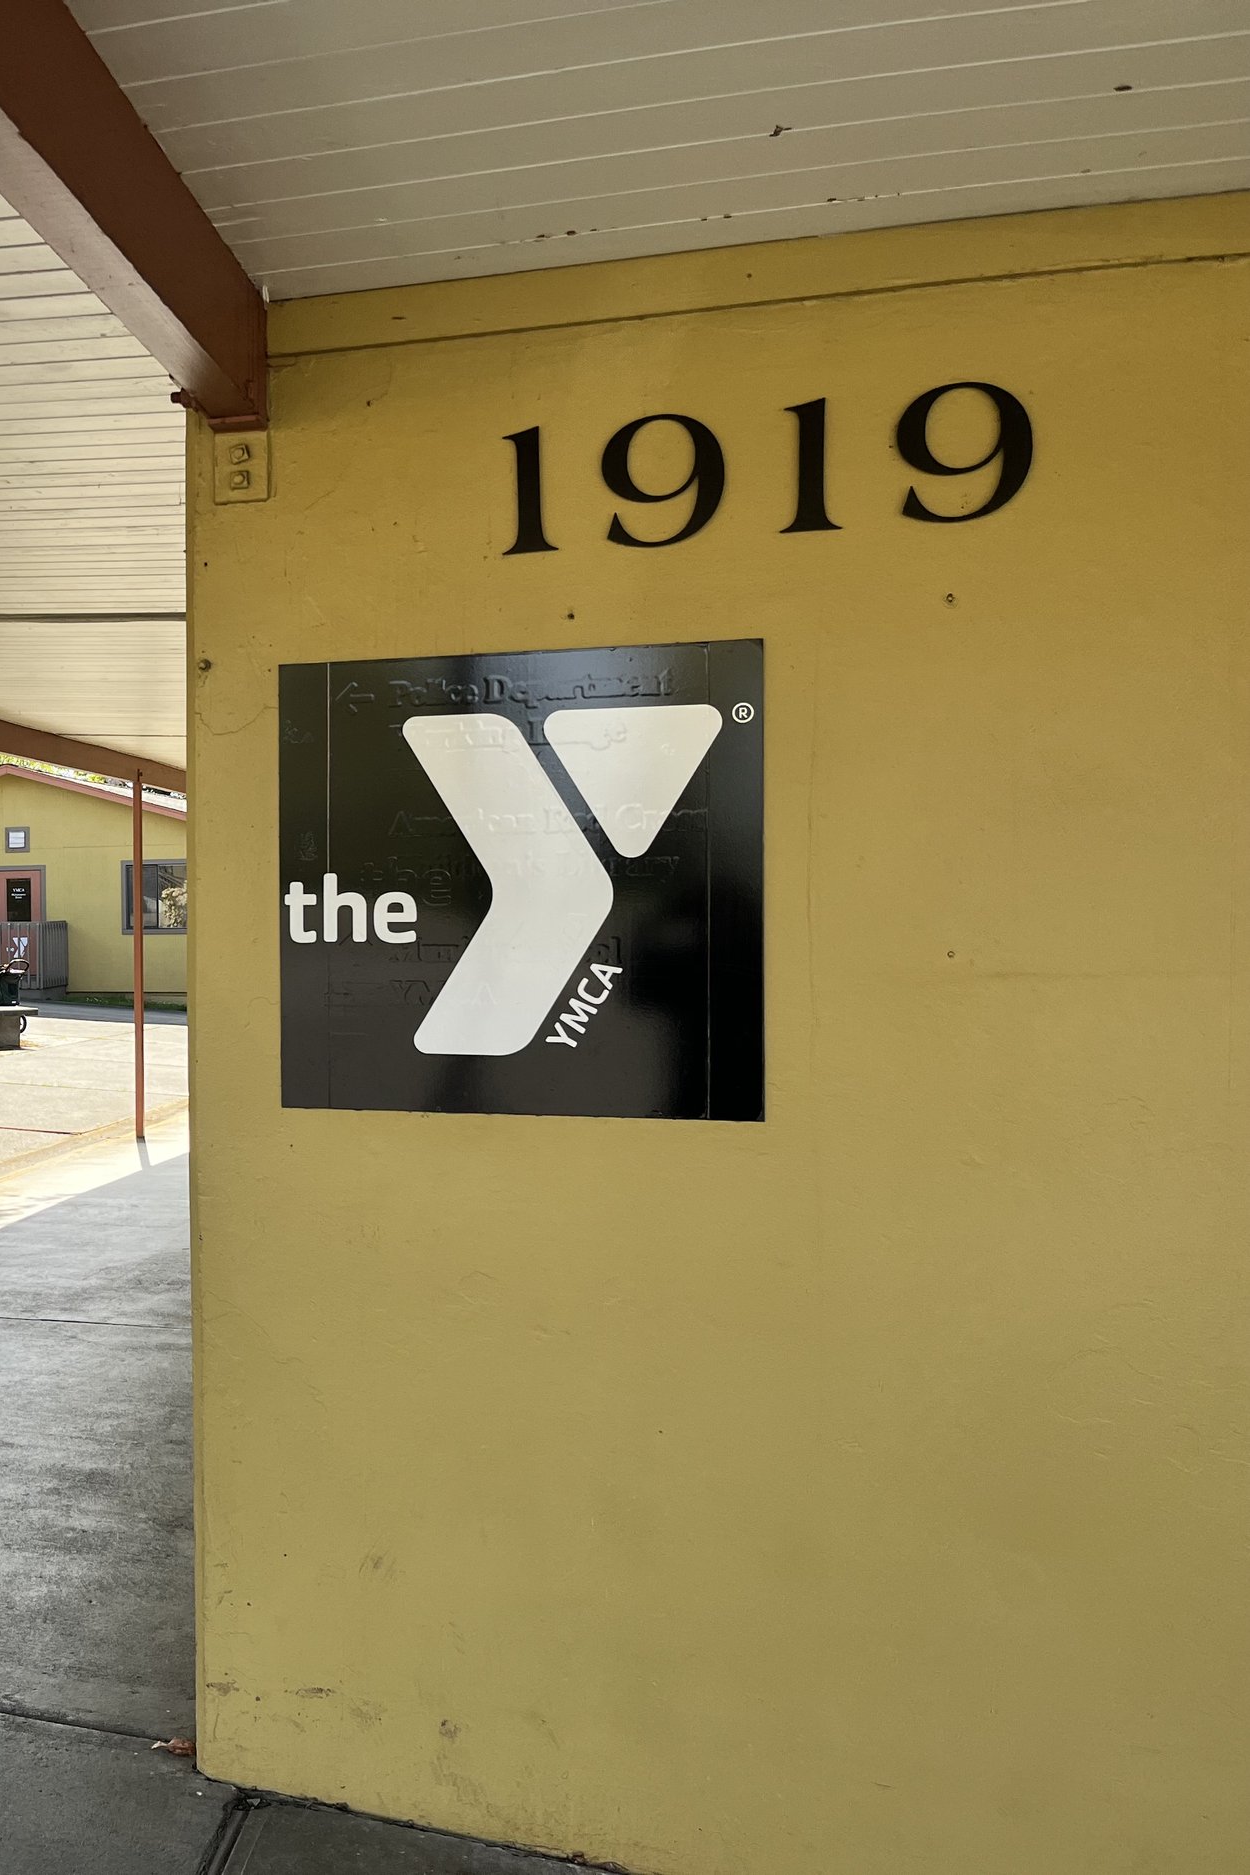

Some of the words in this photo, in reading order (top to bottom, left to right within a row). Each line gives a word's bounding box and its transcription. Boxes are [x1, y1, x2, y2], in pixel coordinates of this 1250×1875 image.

[502, 381, 1033, 556] 1919
[284, 872, 418, 944] the
[544, 961, 624, 1049] YMCA
